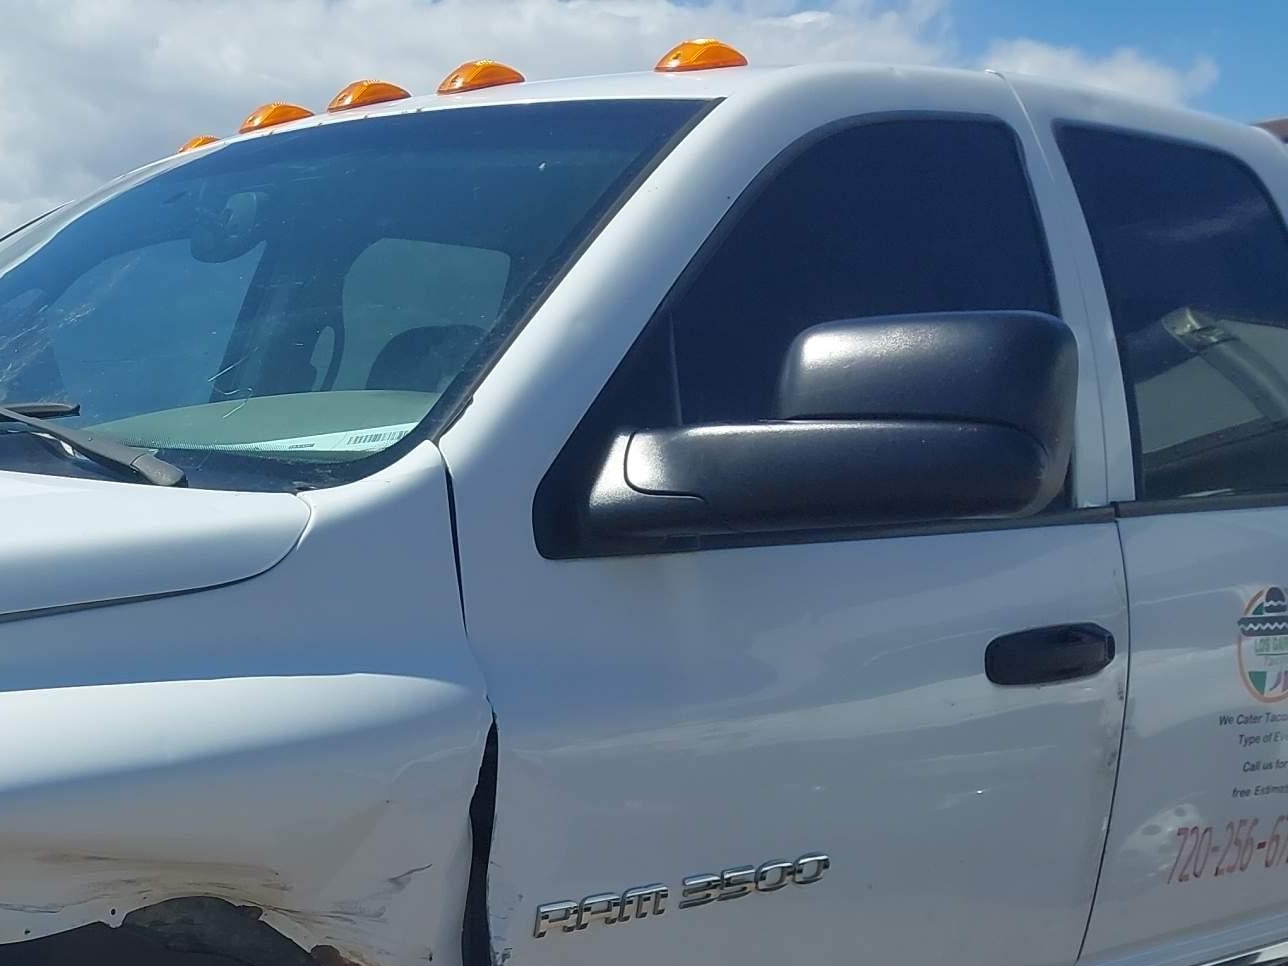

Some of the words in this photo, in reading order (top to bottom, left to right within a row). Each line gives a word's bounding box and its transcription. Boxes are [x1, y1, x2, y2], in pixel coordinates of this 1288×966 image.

[1218, 714, 1234, 726] We
[1236, 713, 1263, 725] Cater
[1239, 734, 1261, 748] Type
[1262, 732, 1273, 744] of
[1242, 760, 1262, 773] Call
[1262, 760, 1273, 770] us
[534, 882, 669, 939] RAM
[678, 850, 831, 910] 3500
